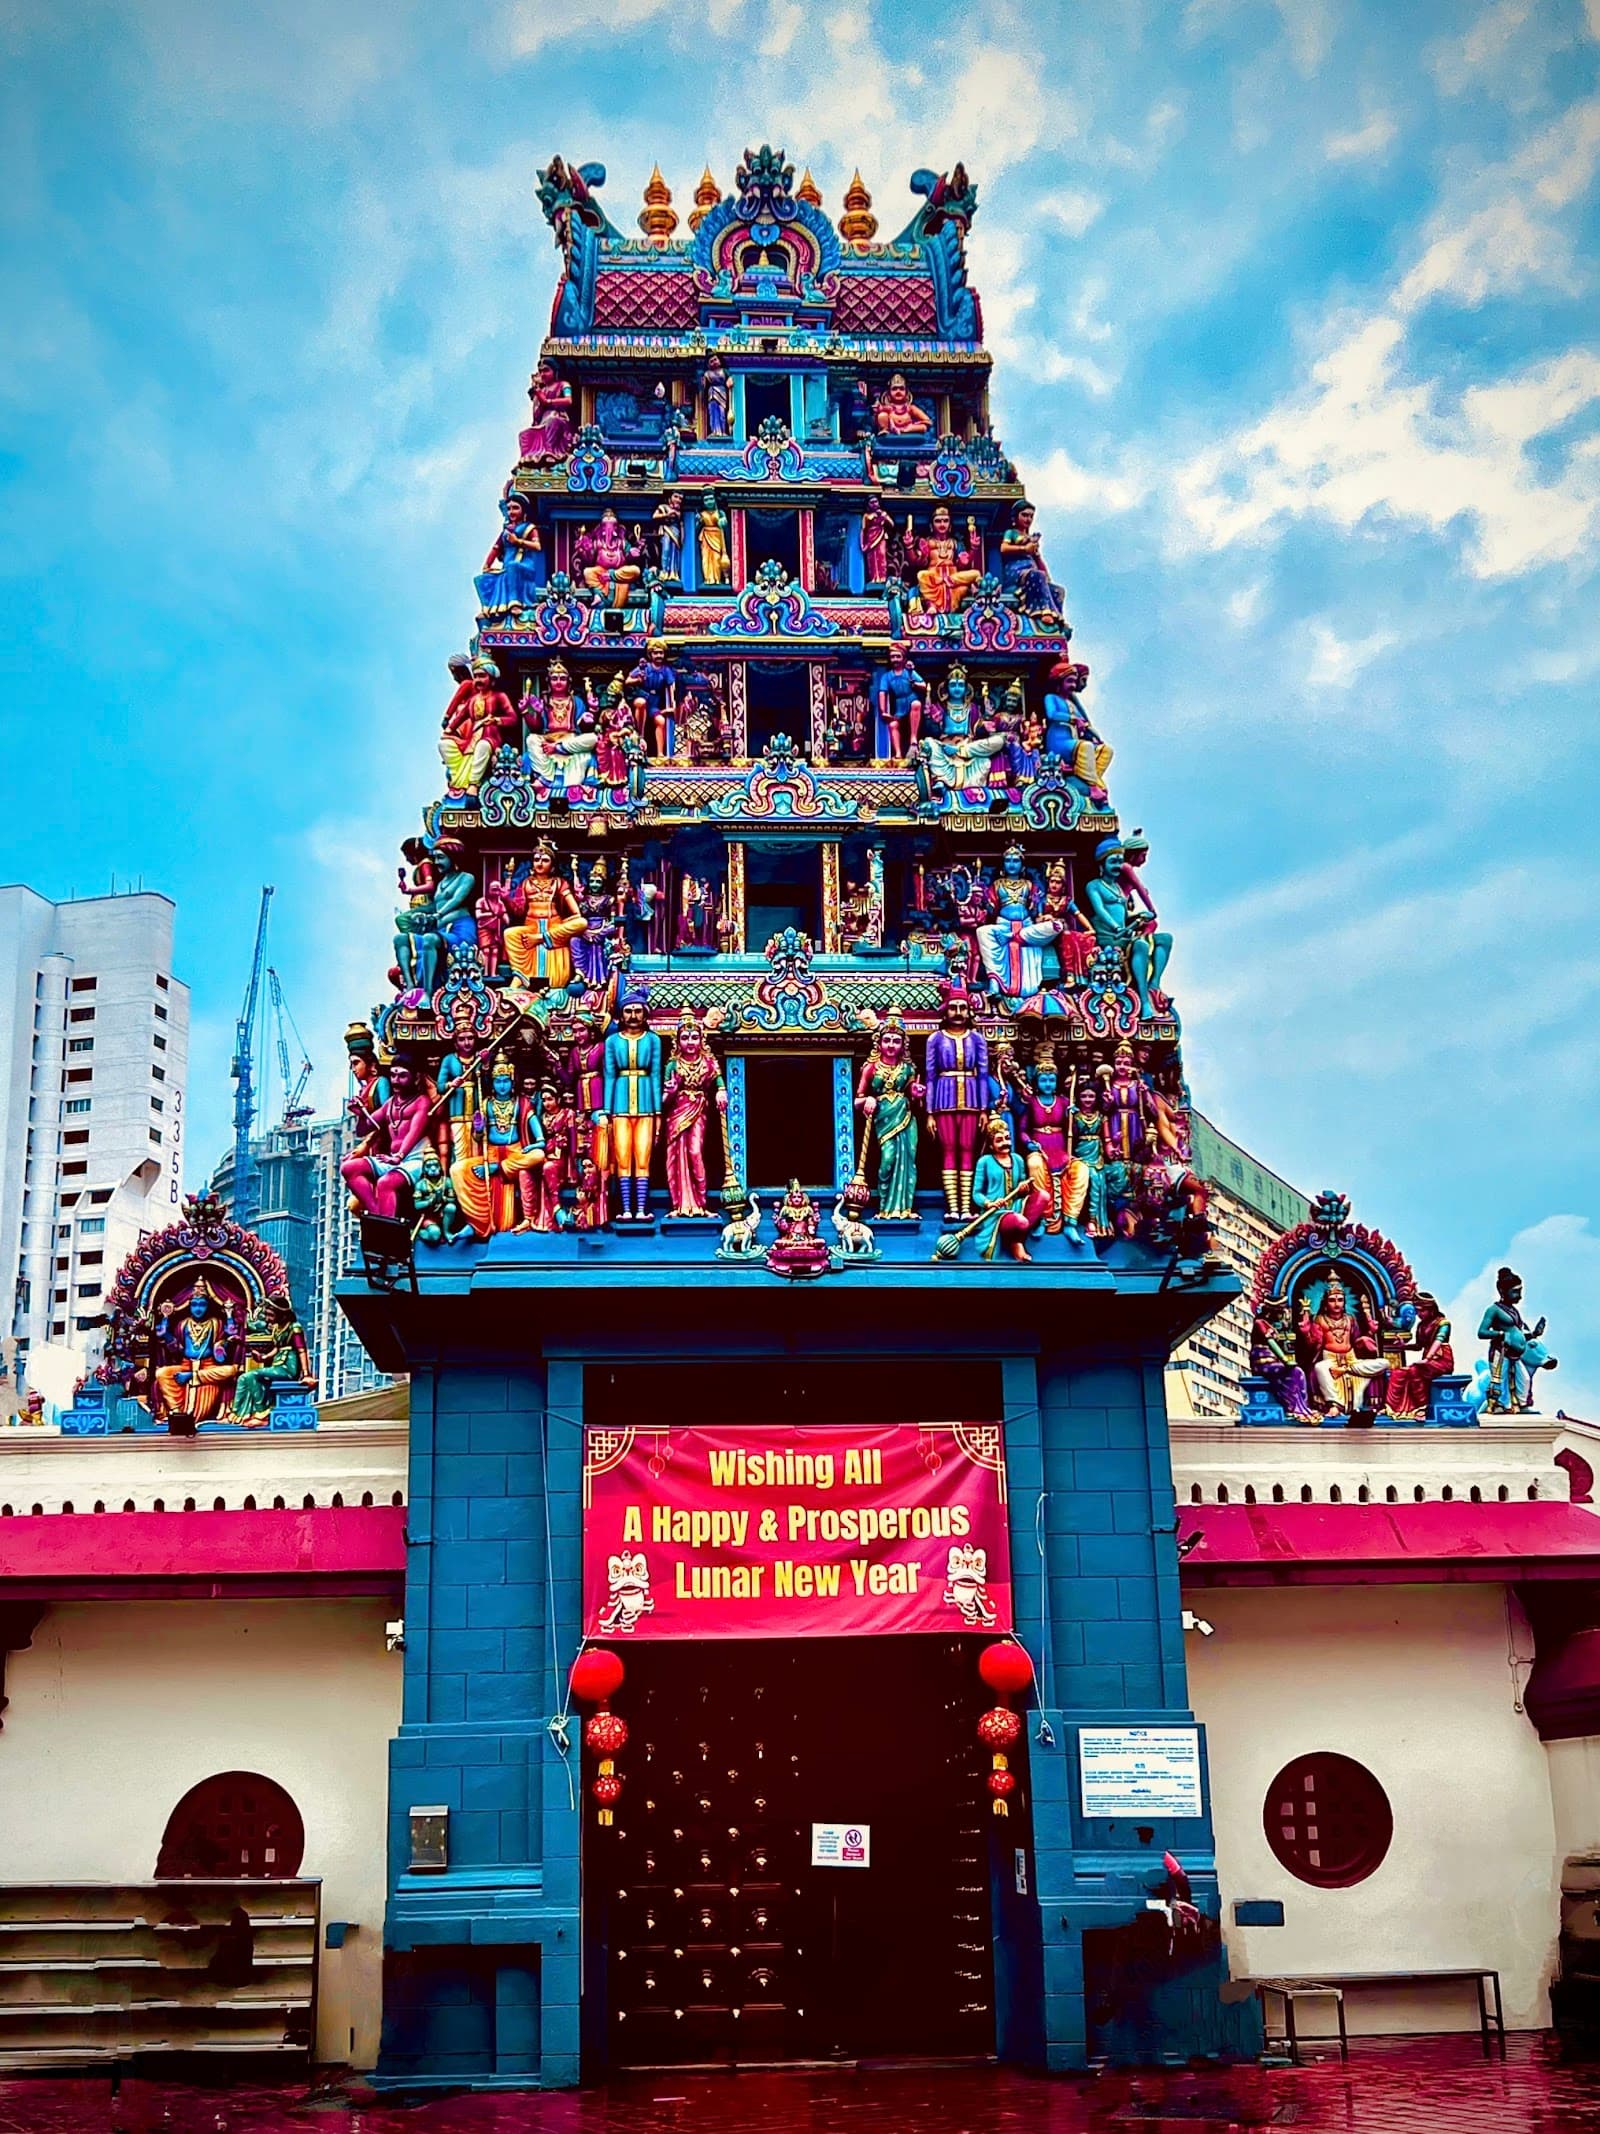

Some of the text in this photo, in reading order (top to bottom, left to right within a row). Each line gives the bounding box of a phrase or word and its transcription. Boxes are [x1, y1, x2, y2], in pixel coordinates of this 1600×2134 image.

[170, 1090, 181, 1204] 335B
[708, 1449, 882, 1489] Wishing All
[623, 1505, 970, 1547] A Happy & Prosperous
[676, 1560, 922, 1599] Lunar New Year
